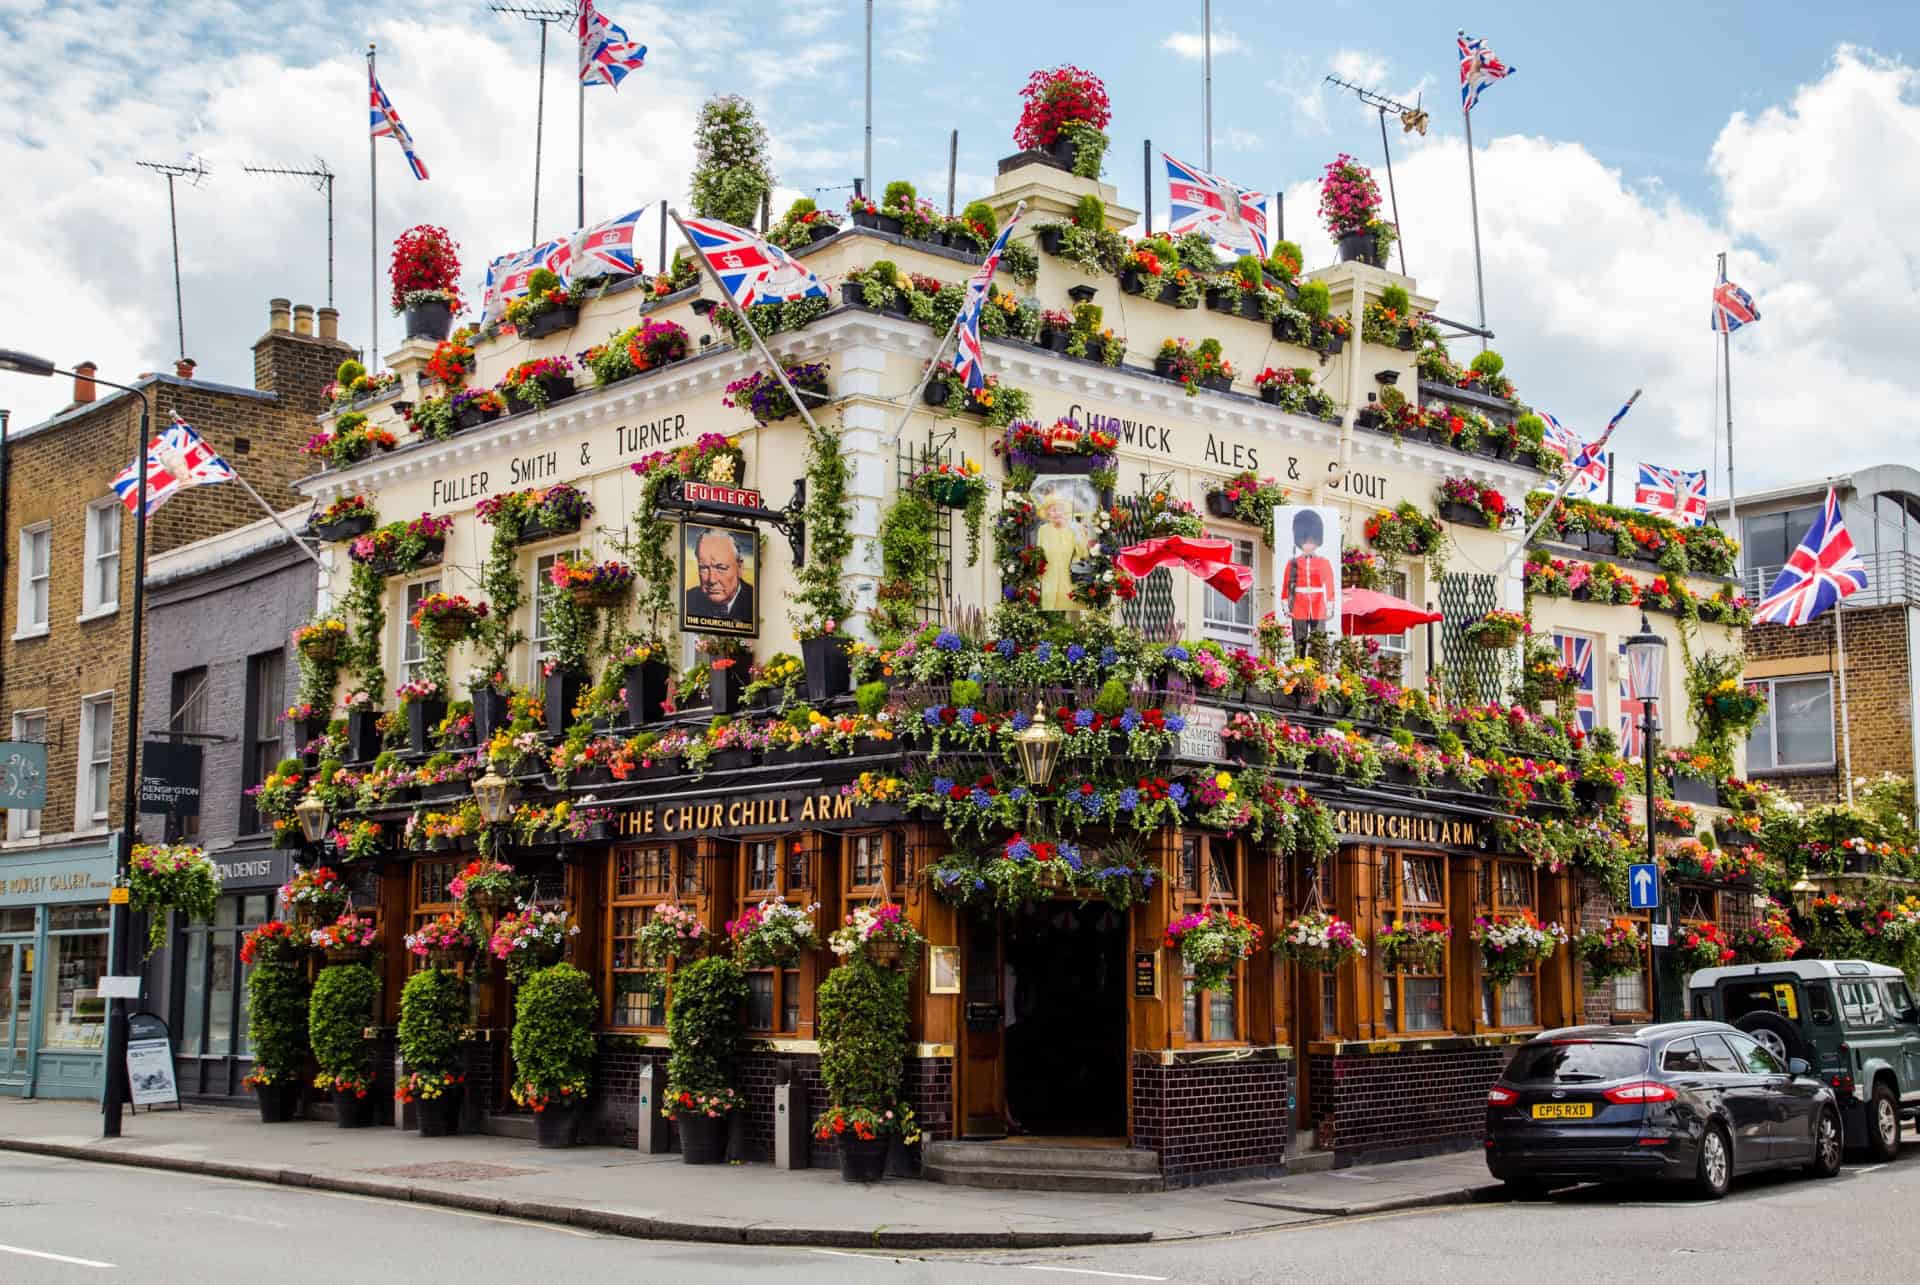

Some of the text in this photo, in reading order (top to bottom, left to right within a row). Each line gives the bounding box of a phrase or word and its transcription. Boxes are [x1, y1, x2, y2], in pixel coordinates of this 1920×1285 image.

[1204, 433, 1259, 470] ALES
[1287, 457, 1300, 480] &
[433, 471, 489, 507] FULLER
[511, 451, 557, 485] SMITH
[580, 442, 591, 467] &
[689, 484, 756, 506] FULLER'S
[687, 616, 699, 625] THE
[700, 617, 735, 628] CHURCHILL
[1184, 726, 1219, 744] CAMPDE
[617, 794, 853, 835] THE CHURCHILL ARM
[1337, 810, 1477, 846] CHURCHILL ARM
[233, 860, 272, 877] DENTIST
